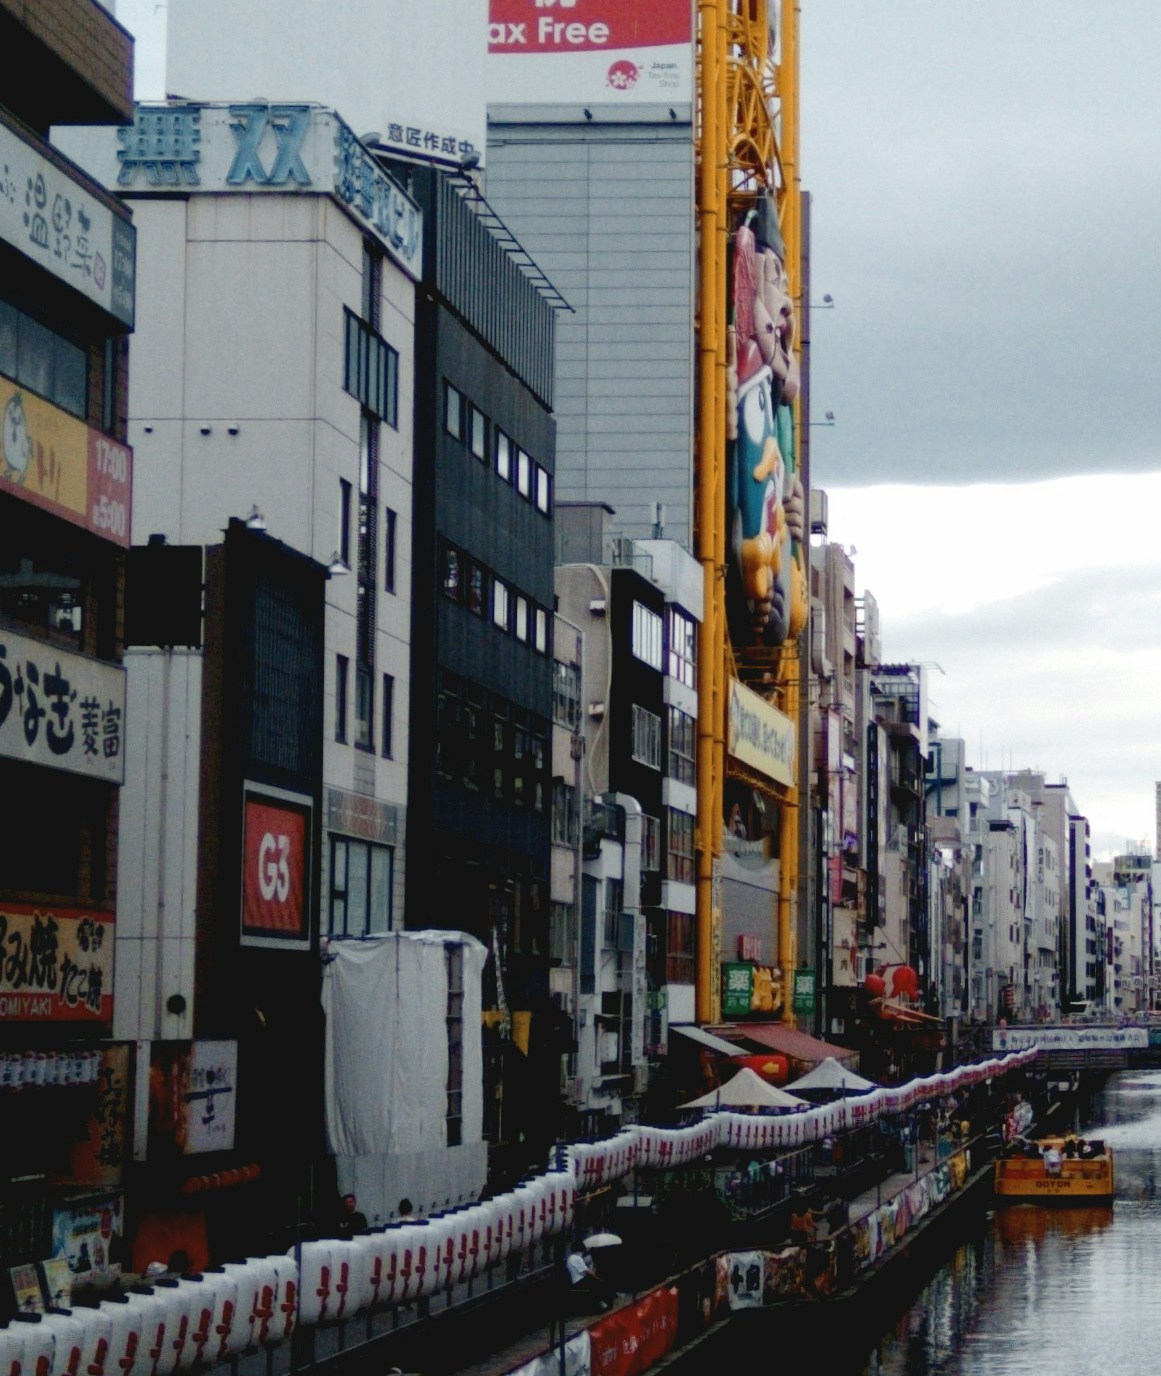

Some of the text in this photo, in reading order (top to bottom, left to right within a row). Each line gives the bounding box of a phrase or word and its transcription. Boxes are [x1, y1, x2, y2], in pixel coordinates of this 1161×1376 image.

[538, 16, 610, 44] Free
[651, 61, 678, 70] Japan
[387, 123, 476, 160] 意匠作成中
[257, 831, 291, 904] G3
